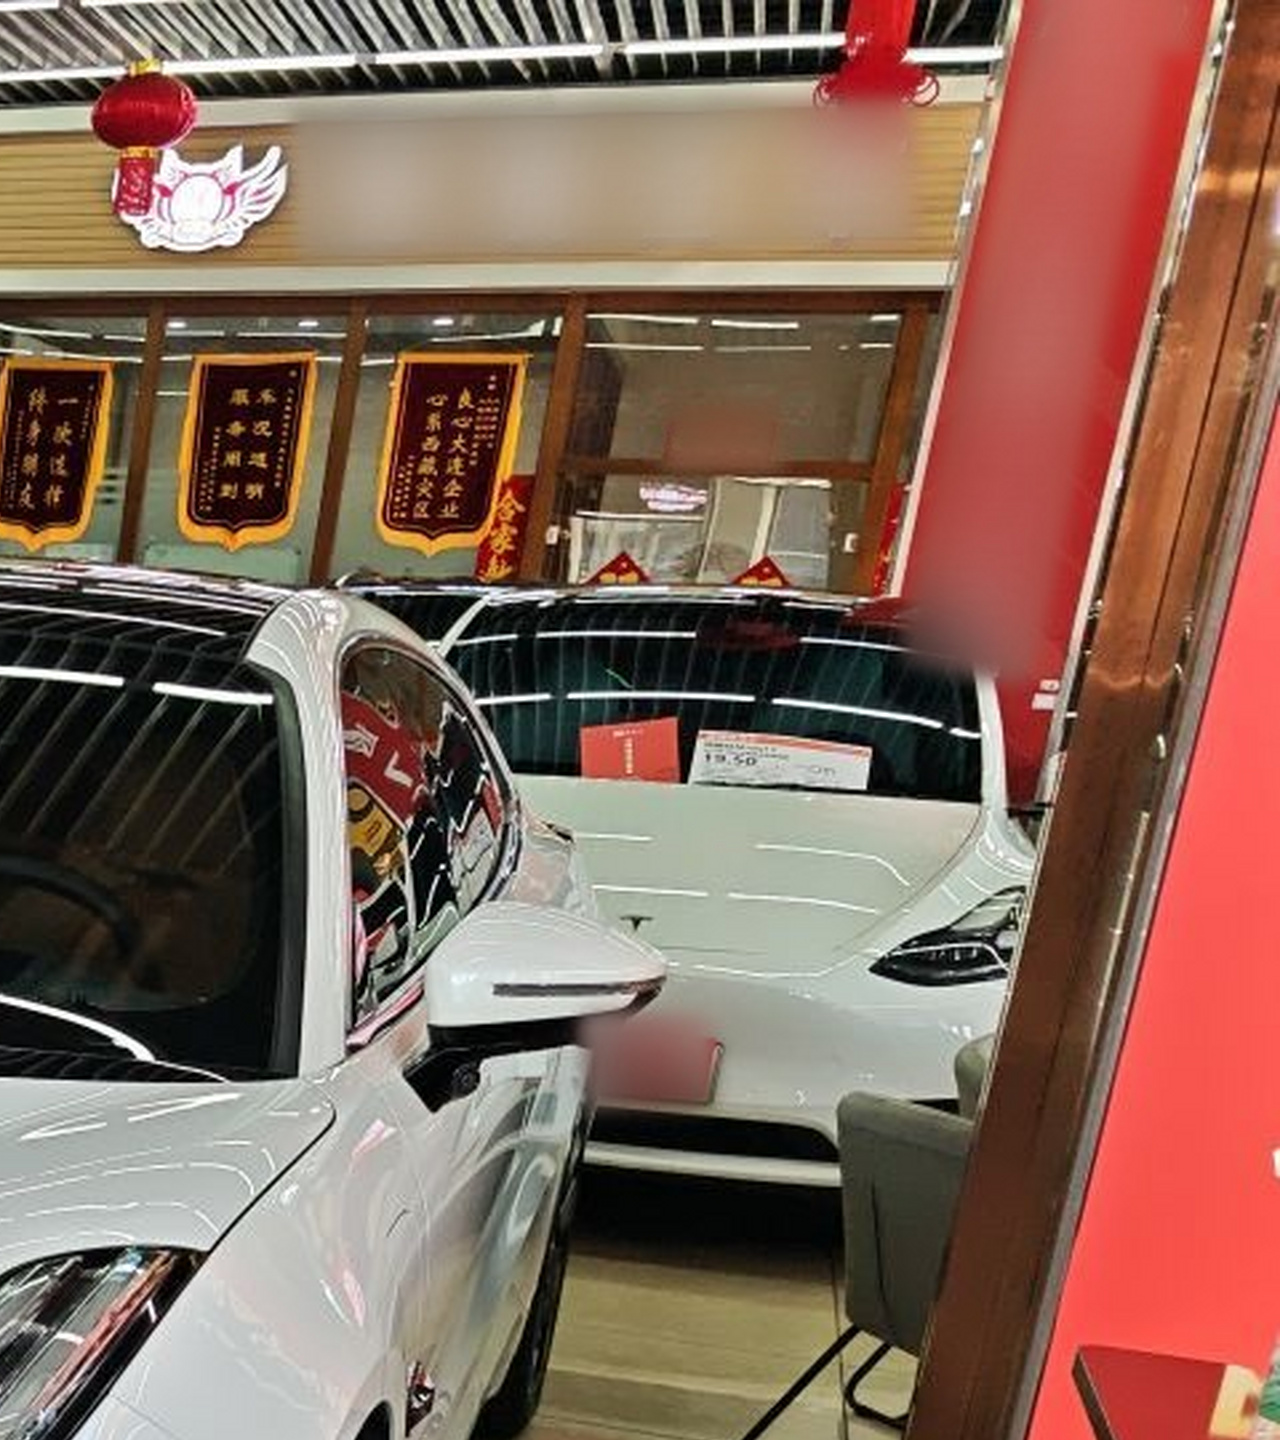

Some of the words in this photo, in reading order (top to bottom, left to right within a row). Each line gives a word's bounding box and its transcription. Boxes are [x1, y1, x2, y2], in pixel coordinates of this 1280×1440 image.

[413, 393, 449, 519] 心系西藏灾区
[438, 387, 475, 519] 良心大连企业
